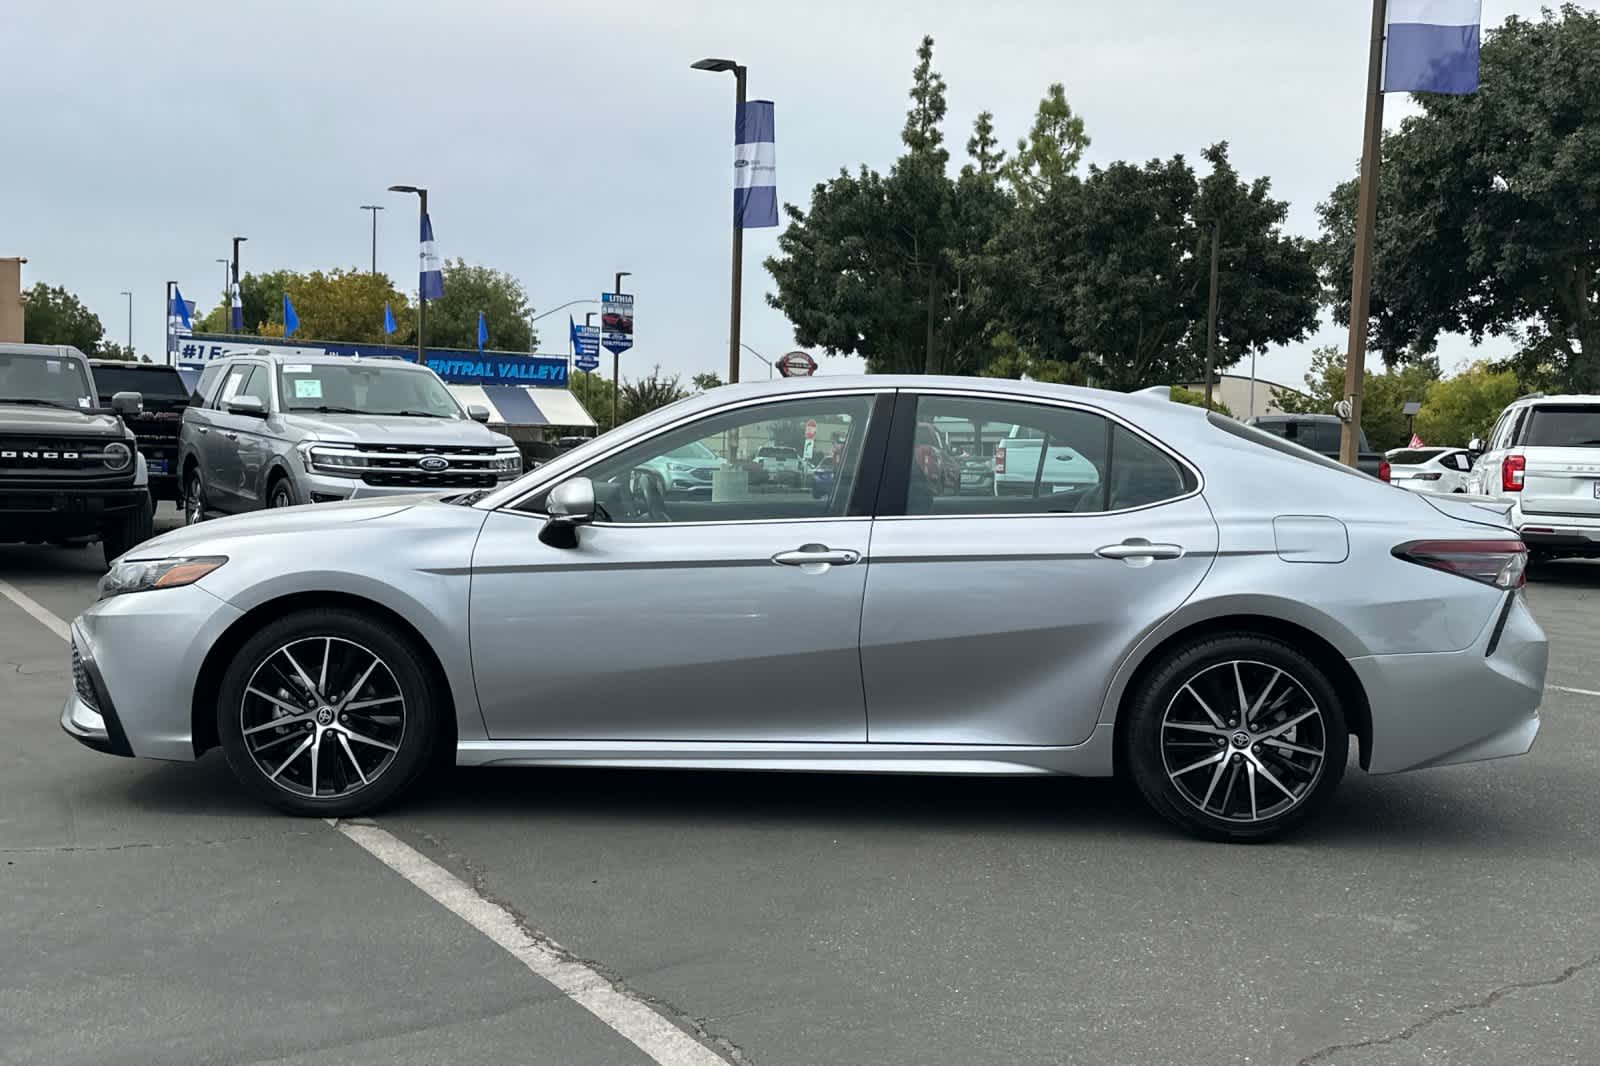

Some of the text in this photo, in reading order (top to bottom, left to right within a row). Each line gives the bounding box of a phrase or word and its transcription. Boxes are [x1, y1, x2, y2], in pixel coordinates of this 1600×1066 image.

[609, 295, 633, 304] LITHIA
[182, 344, 204, 359] #1
[425, 359, 565, 380] ENTRAL VALLEY!
